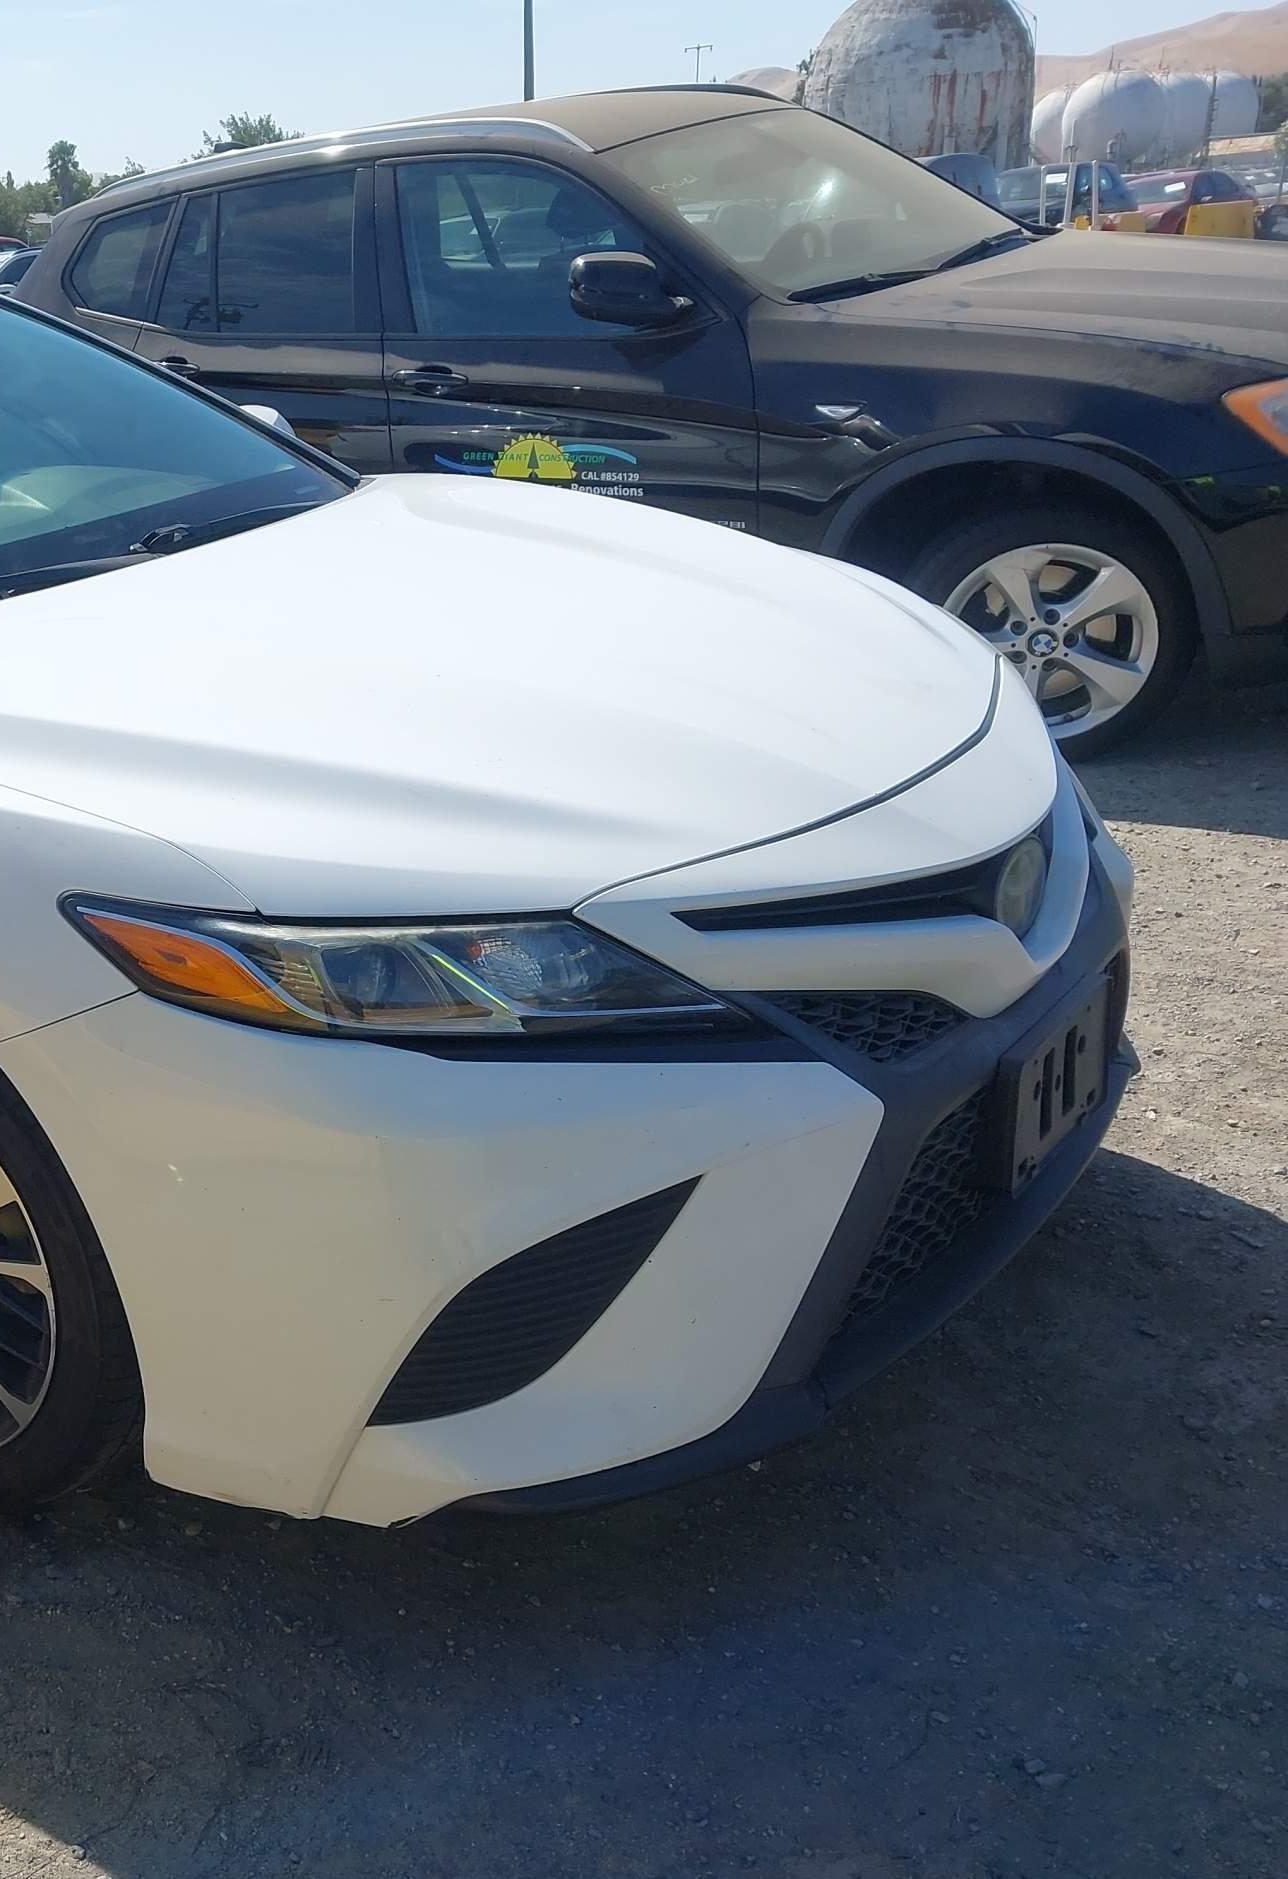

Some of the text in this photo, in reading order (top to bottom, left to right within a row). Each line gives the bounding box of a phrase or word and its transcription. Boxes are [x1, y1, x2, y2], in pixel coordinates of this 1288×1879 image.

[462, 451, 494, 461] GREEN
[538, 453, 606, 464] CONSTRUCTION
[580, 471, 640, 482] CAL #854129
[570, 483, 644, 497] Renovations
